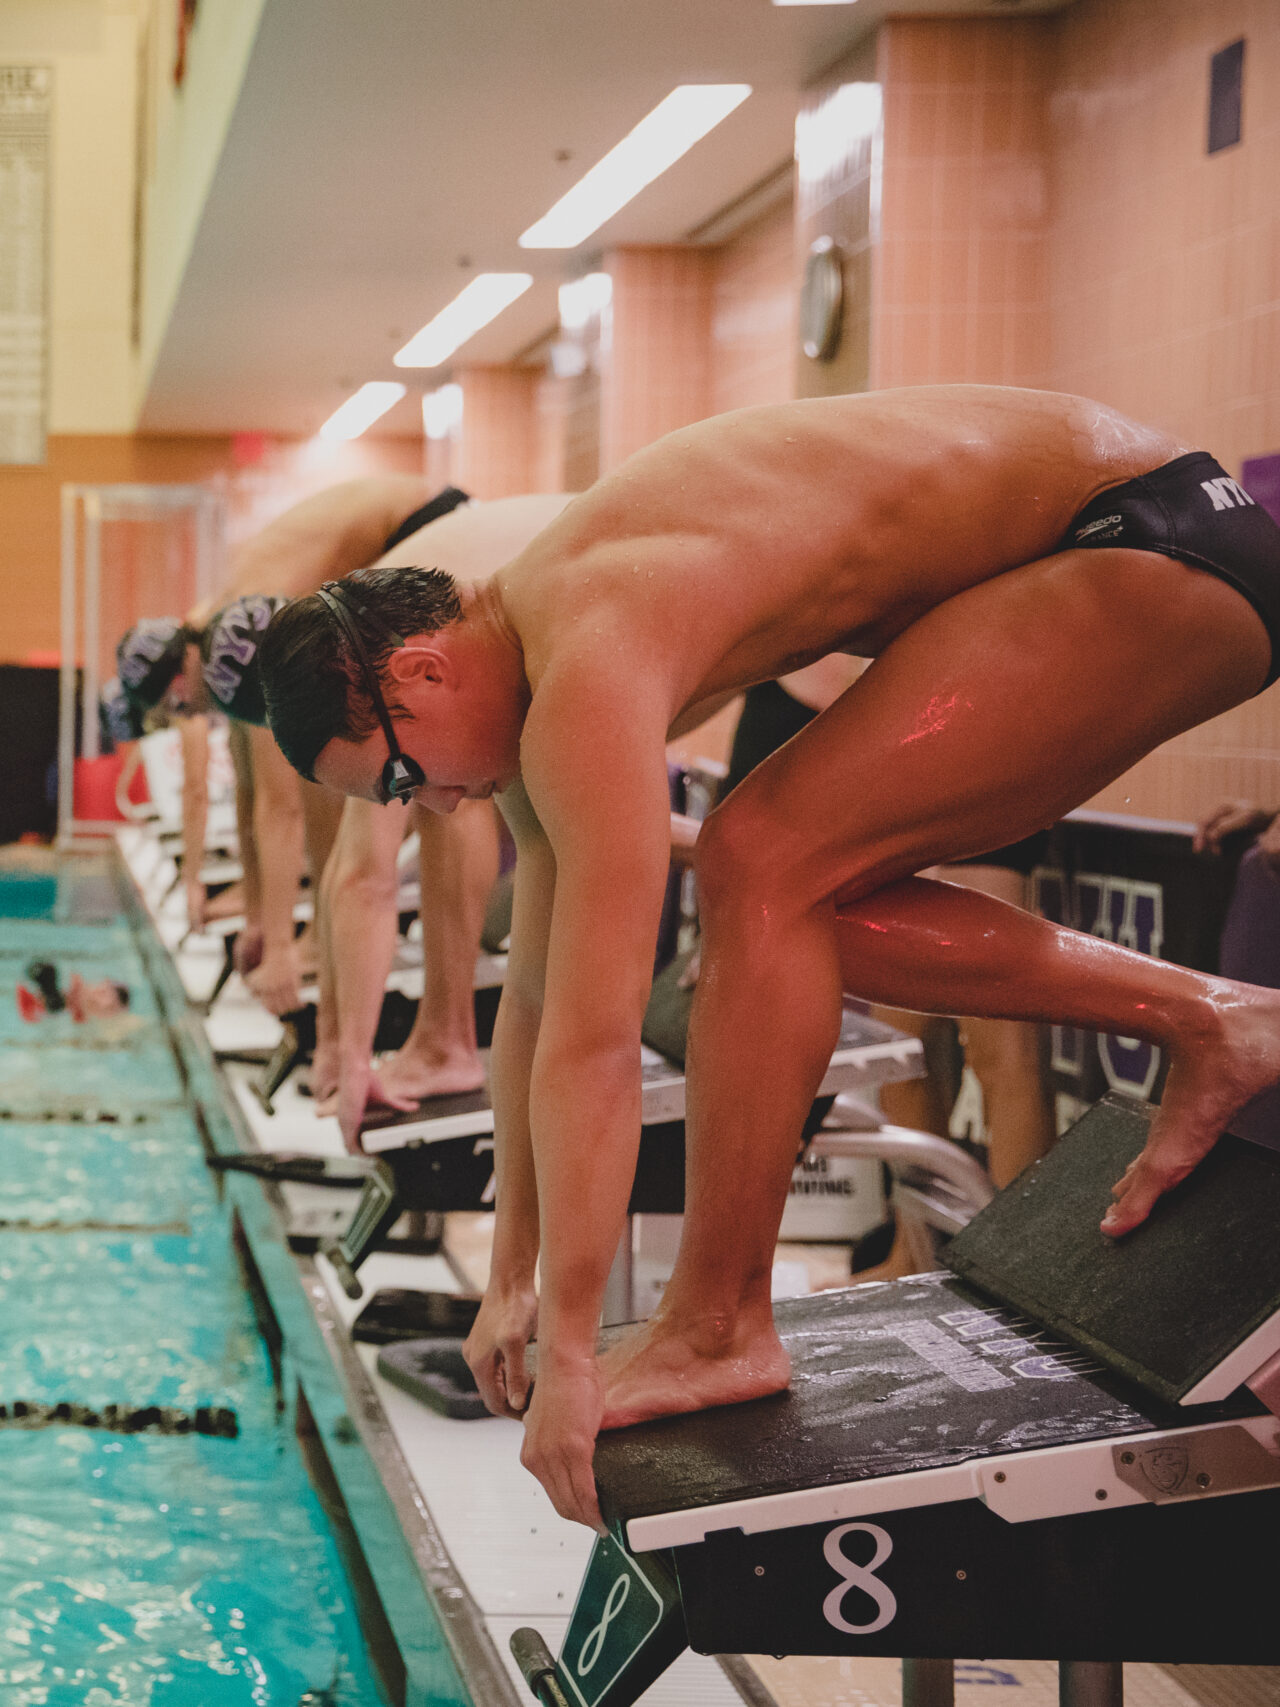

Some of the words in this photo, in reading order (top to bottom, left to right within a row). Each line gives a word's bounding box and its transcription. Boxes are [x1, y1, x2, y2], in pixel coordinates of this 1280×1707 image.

[203, 595, 272, 704] NYU
[577, 1573, 630, 1676] 8
[822, 1522, 897, 1634] 8
